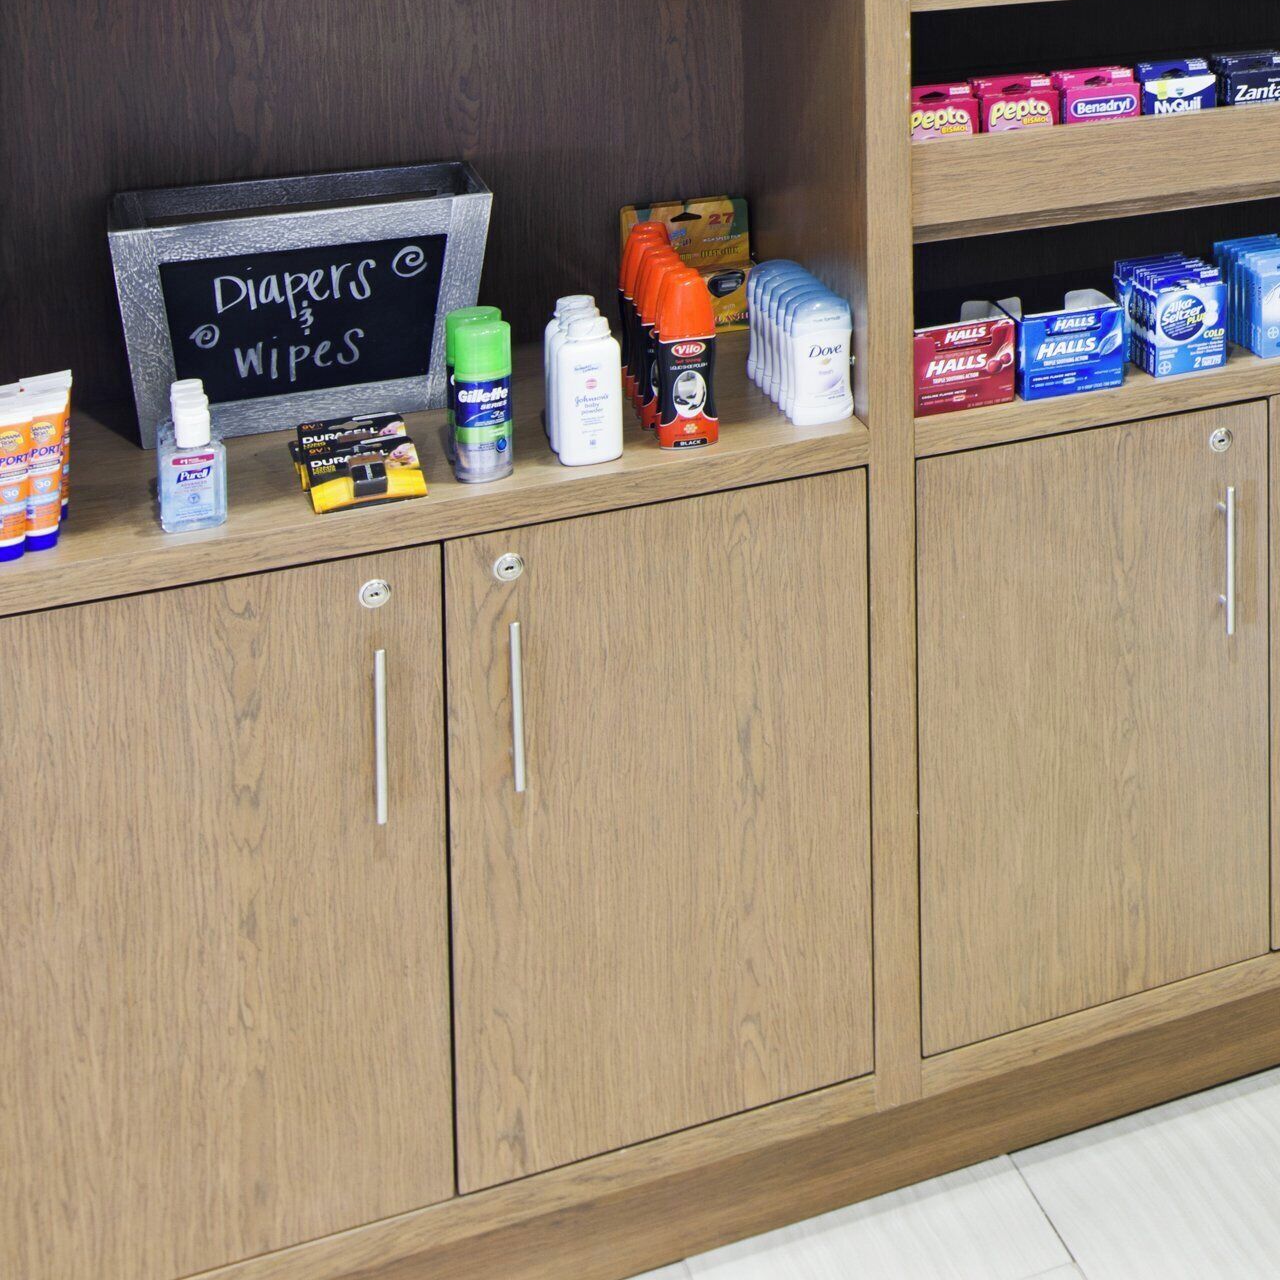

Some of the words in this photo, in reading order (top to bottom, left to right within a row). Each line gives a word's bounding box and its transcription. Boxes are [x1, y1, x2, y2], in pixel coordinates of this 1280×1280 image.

[990, 98, 1049, 127] Pepto
[1076, 97, 1131, 114] Benadryl
[1154, 96, 1202, 116] NyQuil
[910, 106, 969, 131] Pepto
[708, 211, 734, 226] 27
[214, 258, 376, 320] Diapers
[1166, 297, 1197, 313] Alka-
[1053, 315, 1095, 331] HALLS
[1161, 305, 1204, 326] Seltzer
[944, 326, 987, 344] HALLS
[1203, 328, 1225, 339] COLD
[676, 343, 701, 357] Vilo
[808, 342, 842, 359] Dove
[1036, 336, 1097, 361] HALLS
[925, 353, 988, 379] HALLS
[457, 386, 509, 404] Gillette
[480, 399, 508, 410] SERIES
[679, 439, 702, 447] BLACK
[36, 478, 51, 489] 30
[179, 469, 208, 481] Purell
[3, 488, 20, 498] 30
